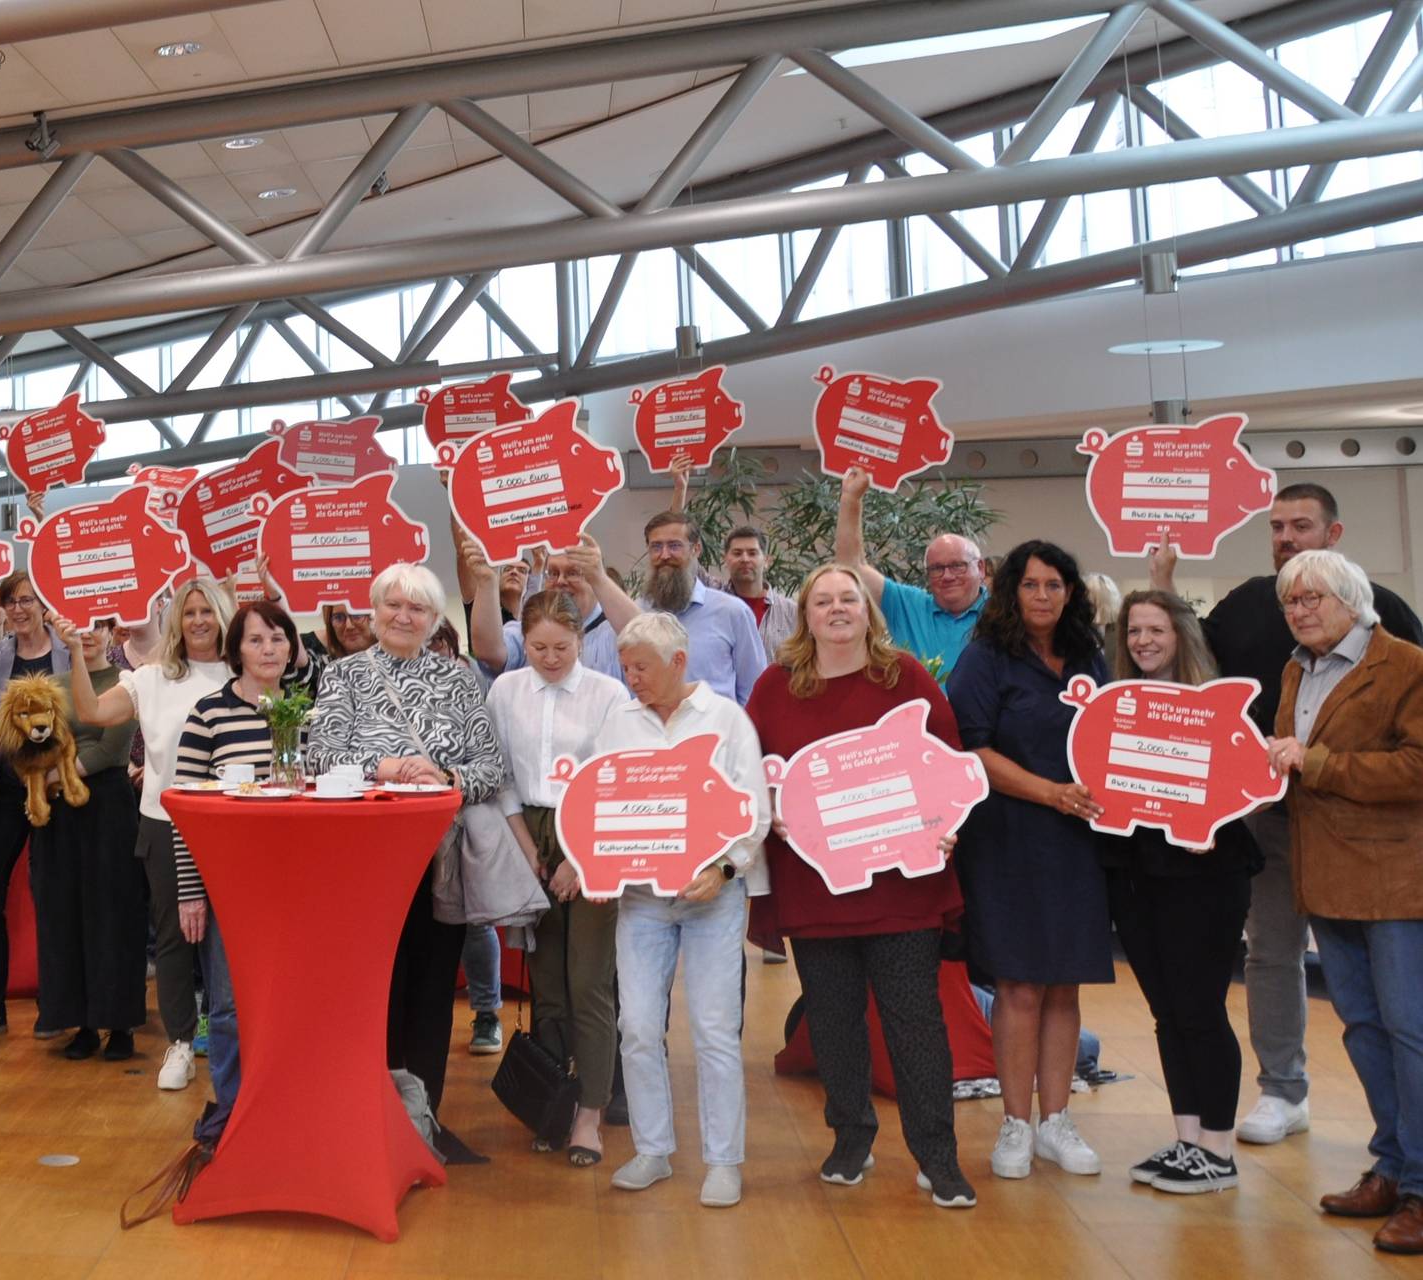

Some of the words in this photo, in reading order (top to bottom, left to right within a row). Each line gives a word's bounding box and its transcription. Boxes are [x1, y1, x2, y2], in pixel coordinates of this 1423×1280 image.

[500, 440, 521, 451] Weil's
[522, 438, 534, 446] um
[534, 433, 553, 444] mehr
[502, 450, 512, 459] als
[513, 446, 530, 456] Geld
[530, 442, 549, 454] geht.
[1183, 450, 1204, 458] geht.
[528, 470, 549, 482] Euro
[315, 502, 334, 510] Weil's
[348, 500, 367, 508] mehr
[343, 509, 361, 517] geht.
[78, 518, 97, 528] Weil's
[109, 514, 127, 523] mehr
[90, 525, 105, 533] Geld
[105, 522, 123, 532] geht.
[342, 535, 357, 543] Euro
[102, 549, 117, 558] Euro
[1148, 701, 1174, 713] Weil's
[1175, 706, 1190, 715] um
[1191, 708, 1215, 718] mehr
[1147, 710, 1160, 719] als
[1161, 712, 1182, 723] Geld
[1182, 716, 1206, 727] geht.
[836, 749, 862, 763] Weil's
[863, 747, 877, 757] um
[877, 741, 900, 753] mehr
[1170, 746, 1189, 756] Euro
[840, 761, 852, 771] als
[853, 756, 872, 768] Geld
[873, 751, 896, 765] geht.
